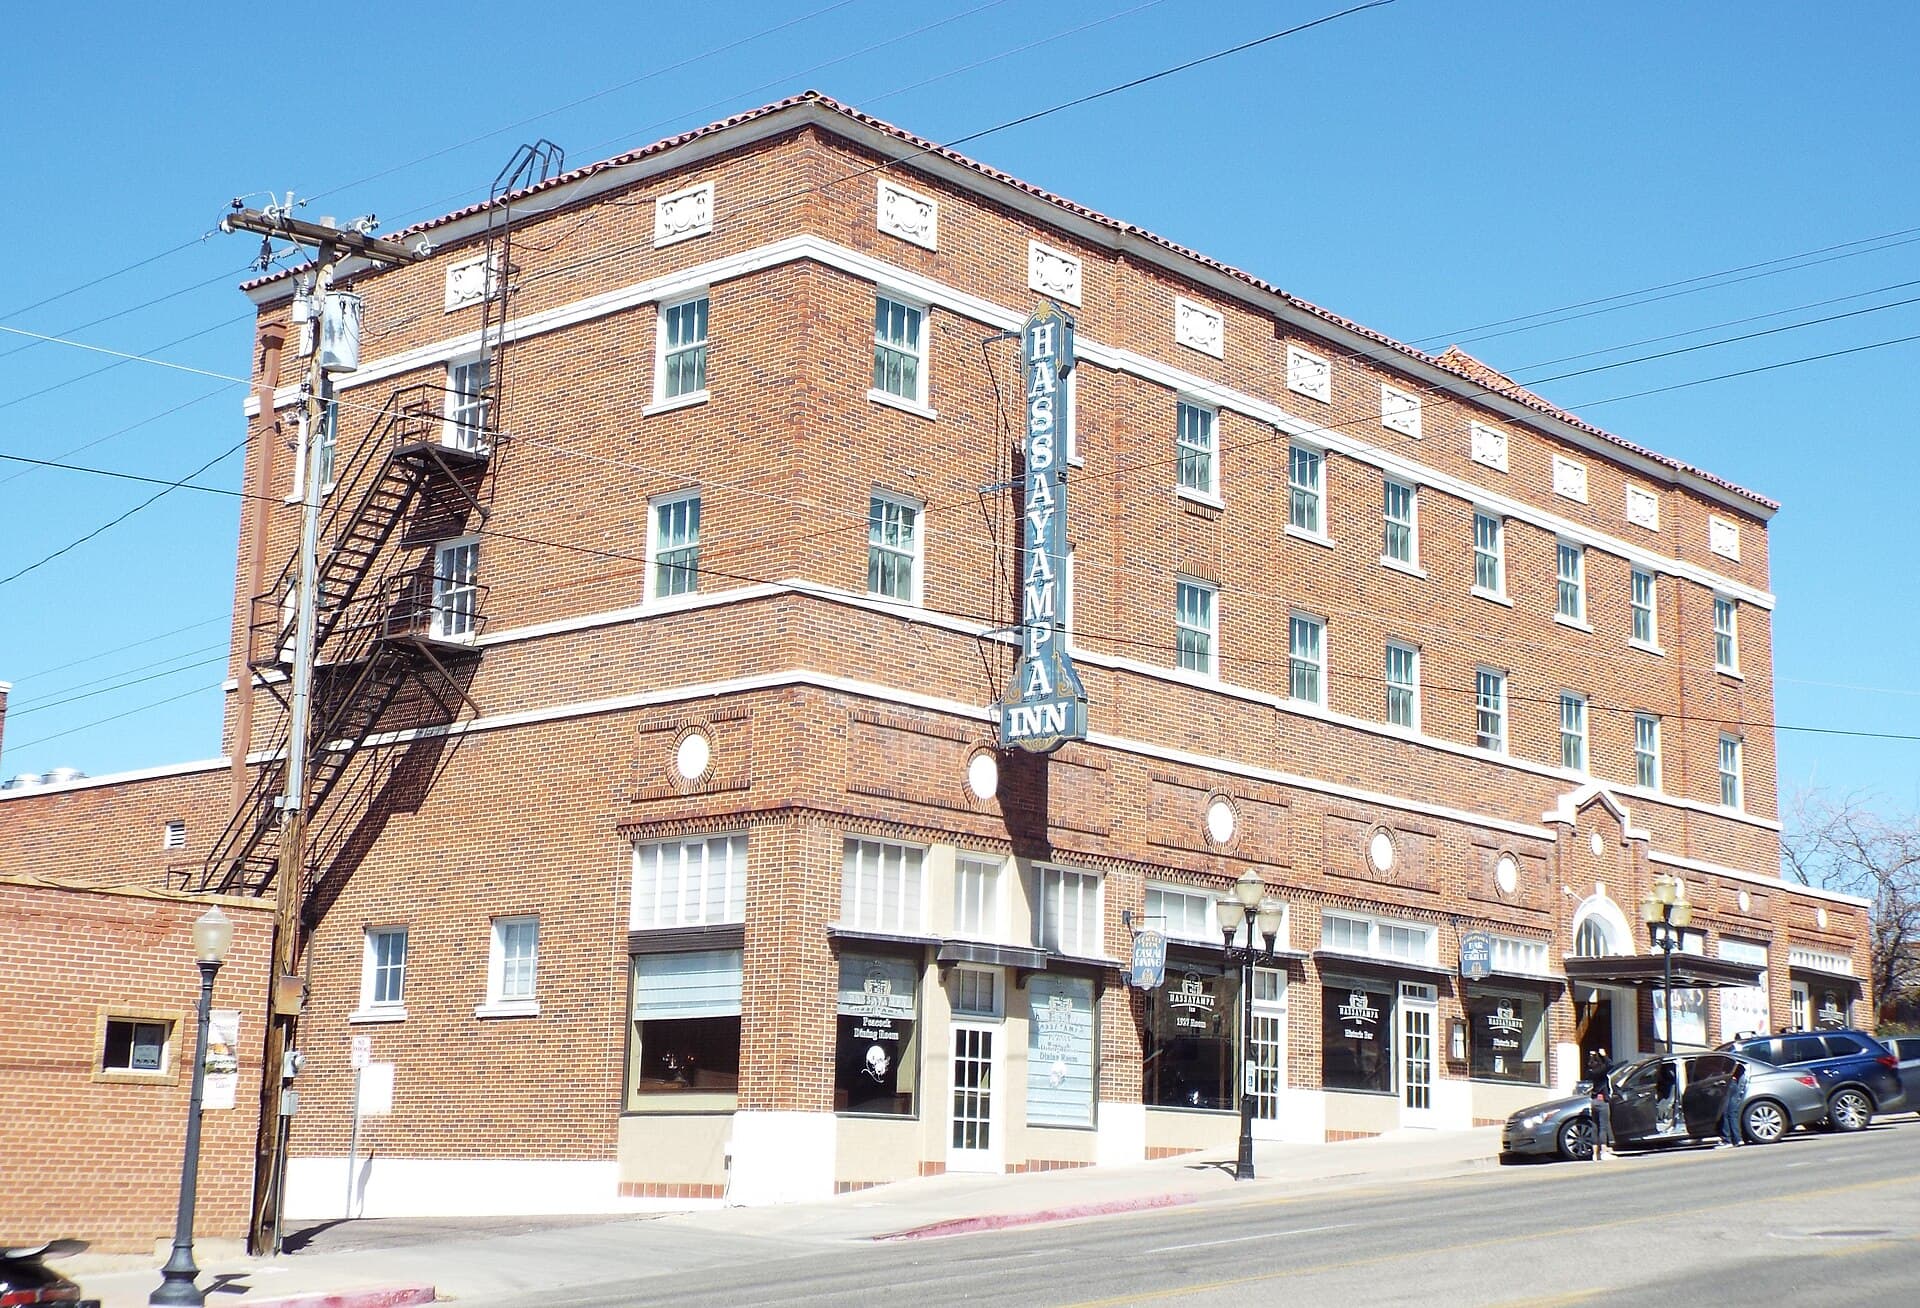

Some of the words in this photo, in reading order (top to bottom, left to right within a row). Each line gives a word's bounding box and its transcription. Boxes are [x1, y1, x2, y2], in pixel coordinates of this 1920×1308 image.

[1024, 322, 1056, 698] HASSAYAMPA
[1008, 702, 1068, 736] INN
[1169, 993, 1215, 1006] HASSAYAMPA
[853, 1027, 878, 1041] Dining
[878, 1029, 900, 1041] Room
